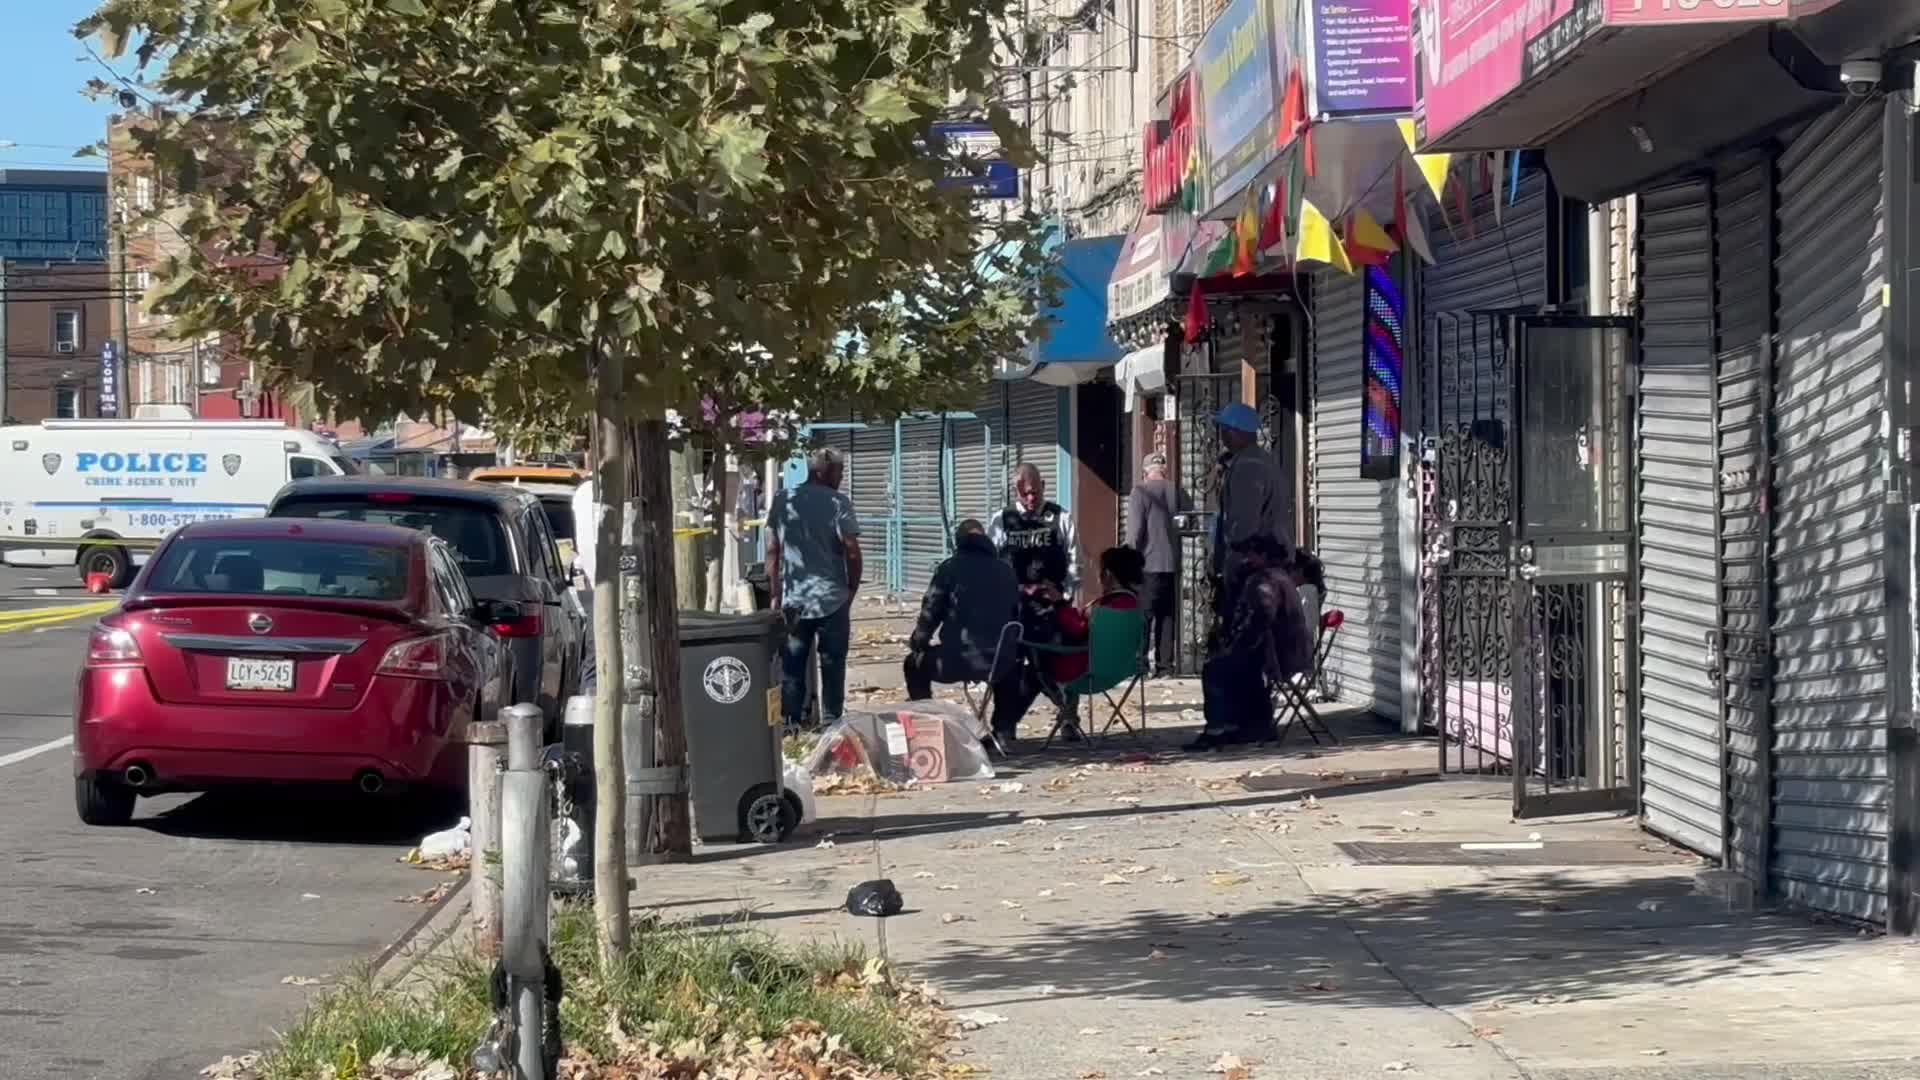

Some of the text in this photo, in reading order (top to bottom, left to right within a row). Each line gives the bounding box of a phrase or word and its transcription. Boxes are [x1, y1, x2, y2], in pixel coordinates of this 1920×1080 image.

[76, 452, 207, 473] POLICE
[85, 477, 197, 487] CRIME SCENE UNIT
